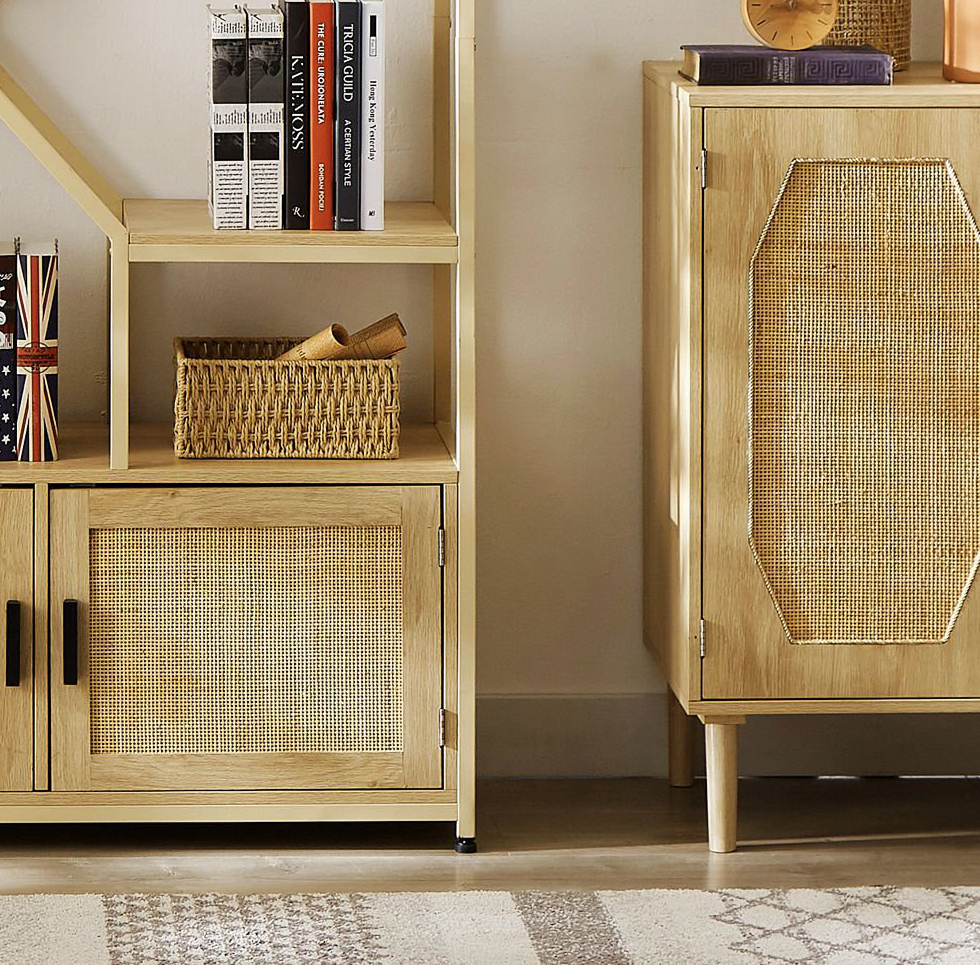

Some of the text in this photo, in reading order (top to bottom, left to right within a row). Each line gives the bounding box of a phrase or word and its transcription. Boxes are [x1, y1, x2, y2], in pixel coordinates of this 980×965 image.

[317, 22, 325, 38] THE
[343, 23, 354, 102] TRICIA GUILD
[367, 80, 377, 162] Hong Kong Yesterday
[344, 162, 352, 187] STYLE
